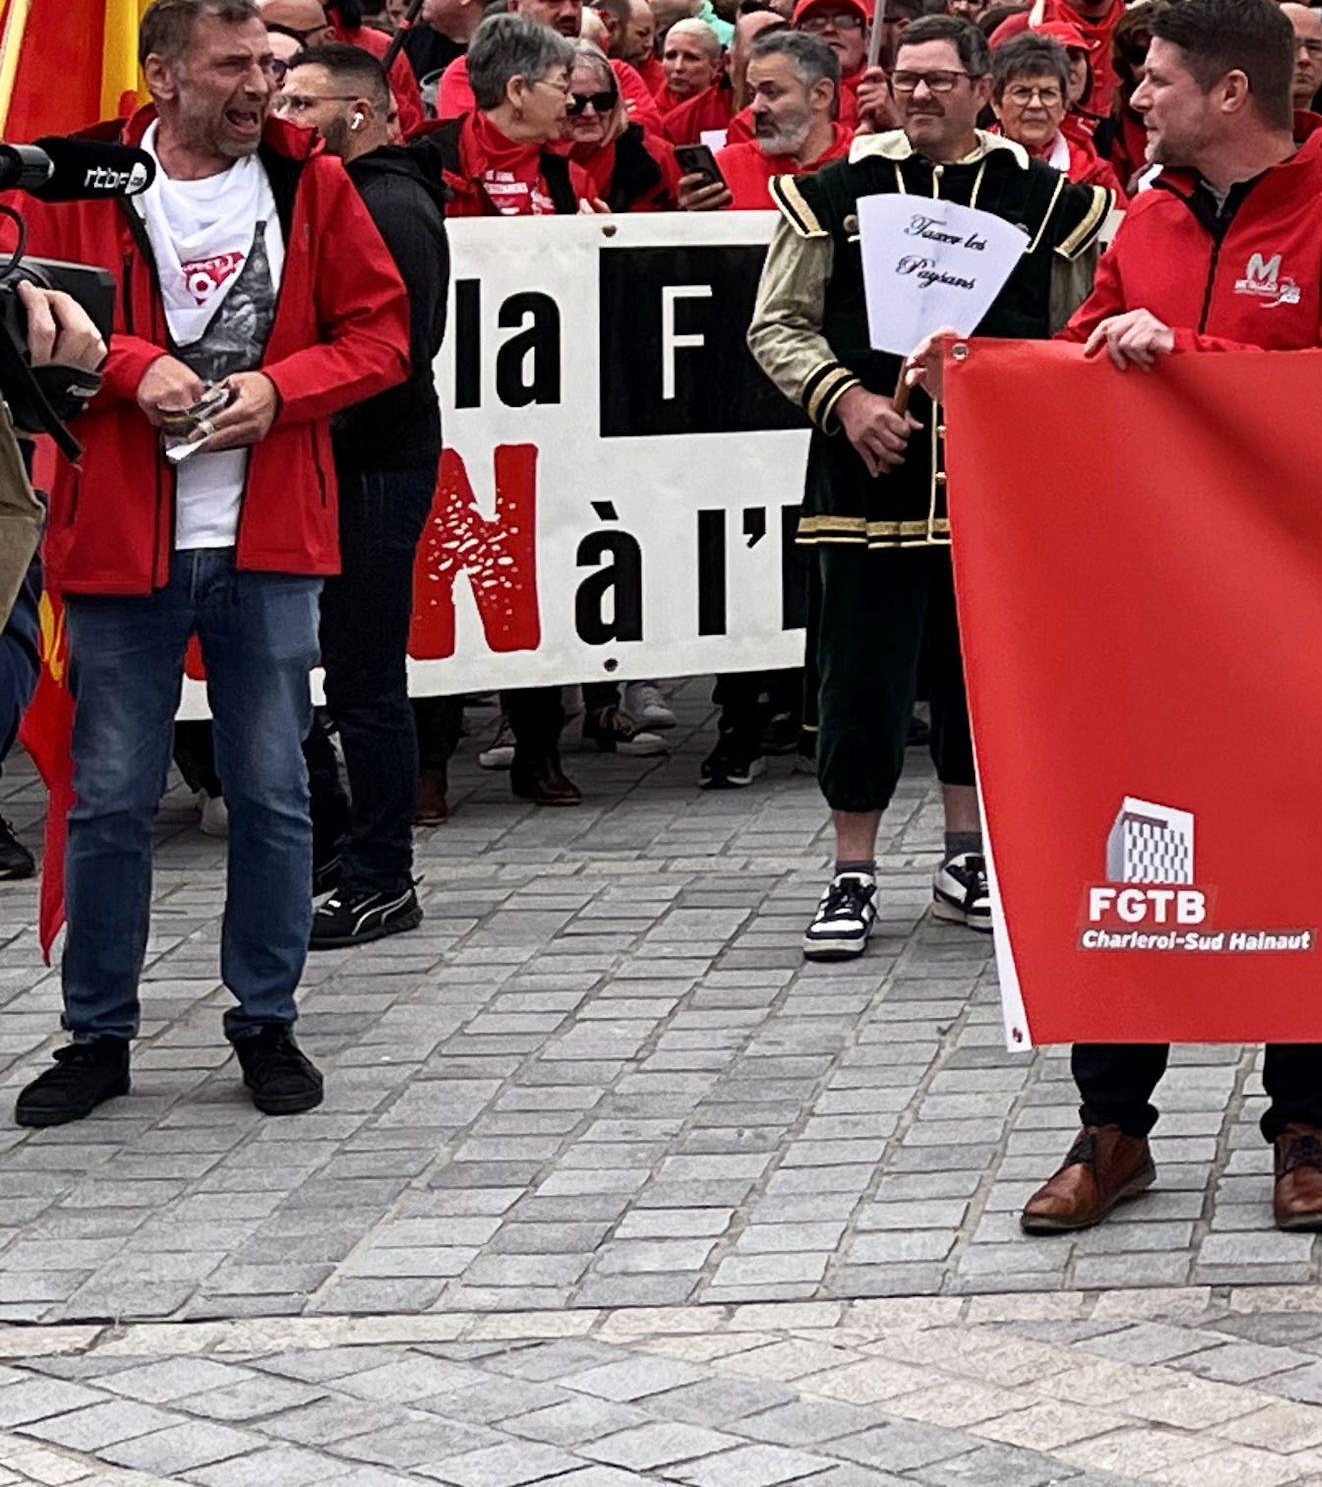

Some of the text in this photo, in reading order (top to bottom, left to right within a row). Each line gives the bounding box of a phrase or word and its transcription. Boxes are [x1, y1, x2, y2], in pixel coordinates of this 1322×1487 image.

[895, 254, 977, 290] Paysans
[455, 278, 562, 409] la
[574, 499, 643, 646] à
[1089, 887, 1206, 924] FGTB
[1082, 929, 1311, 951] Charleroi-Sud Hainaut
